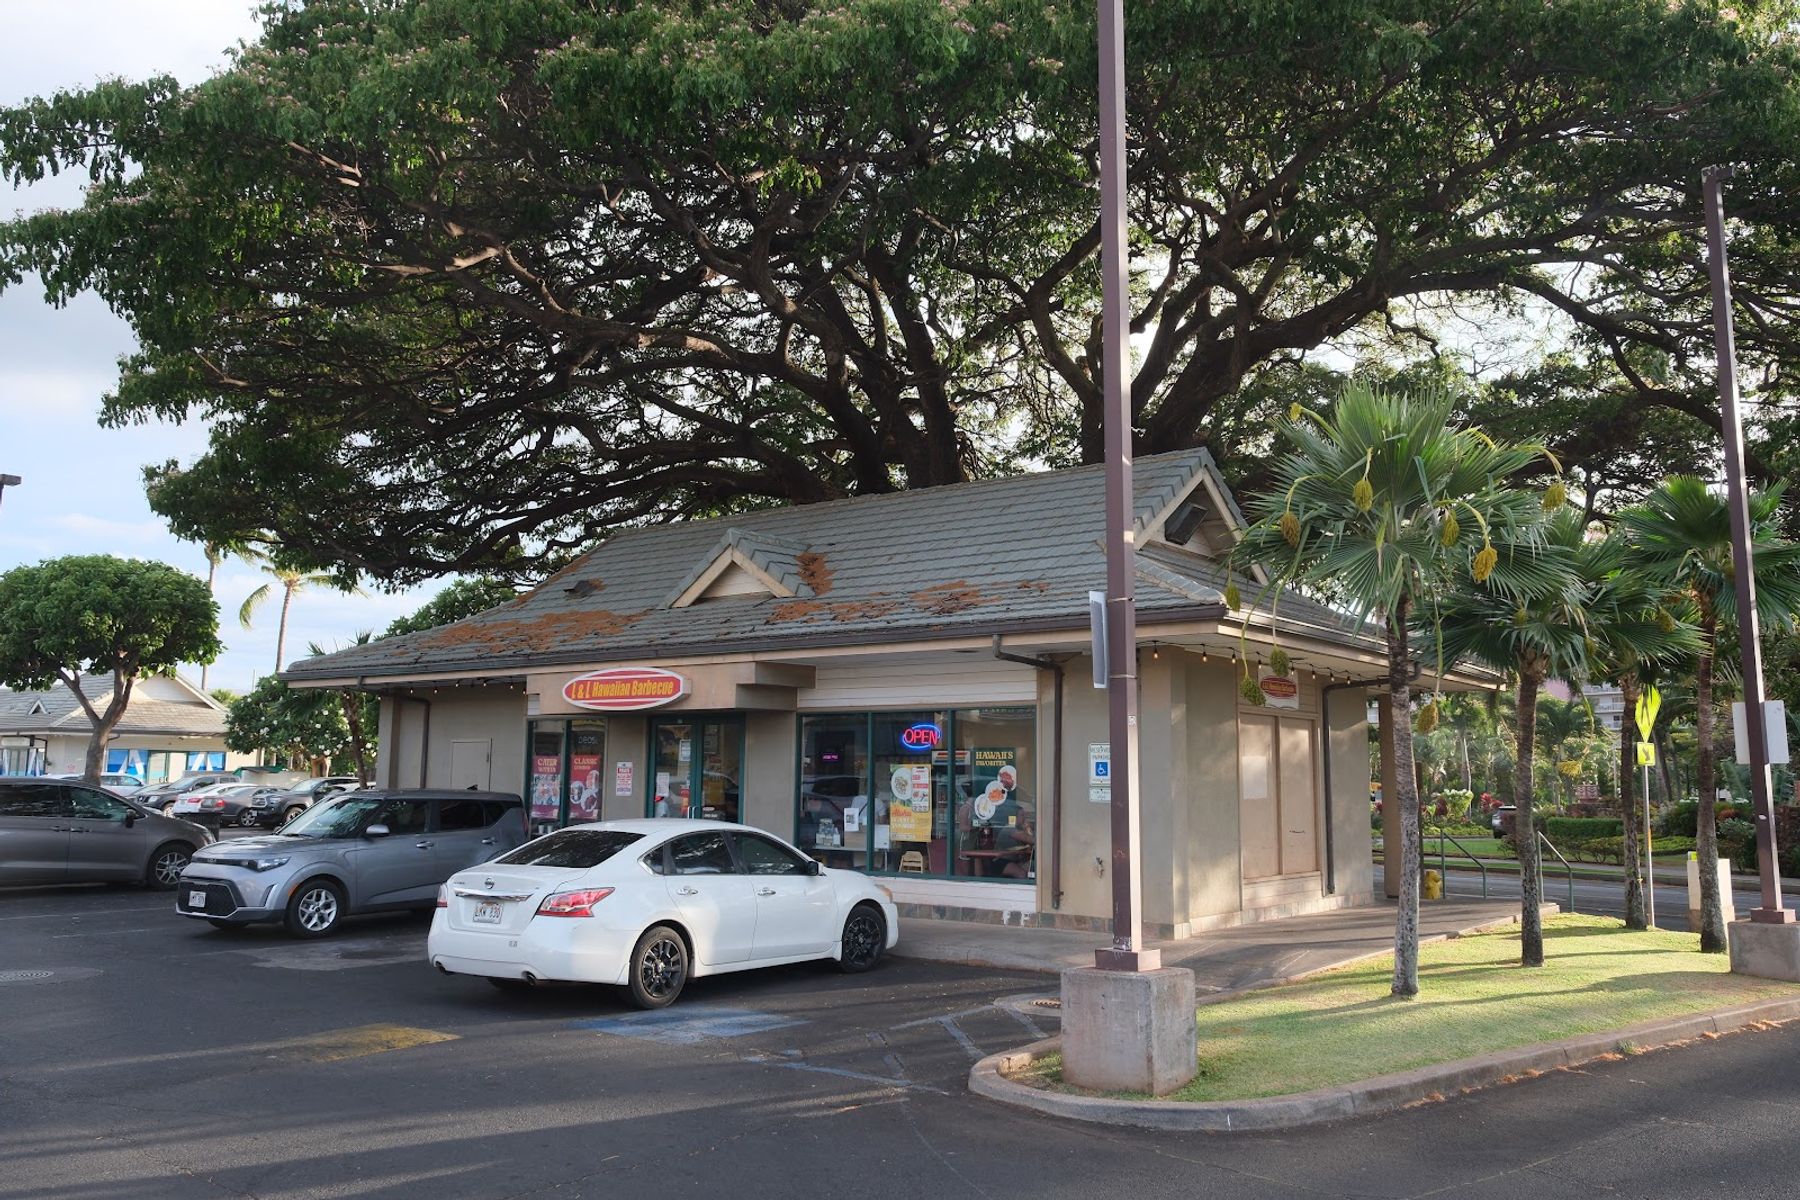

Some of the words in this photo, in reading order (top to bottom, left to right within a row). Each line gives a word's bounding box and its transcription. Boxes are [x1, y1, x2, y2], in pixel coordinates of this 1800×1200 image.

[572, 682, 577, 699] L
[577, 684, 585, 699] &
[585, 681, 591, 699] L
[592, 681, 631, 697] Hawaiian
[632, 680, 674, 696] Barbecue
[904, 728, 938, 745] OPEN
